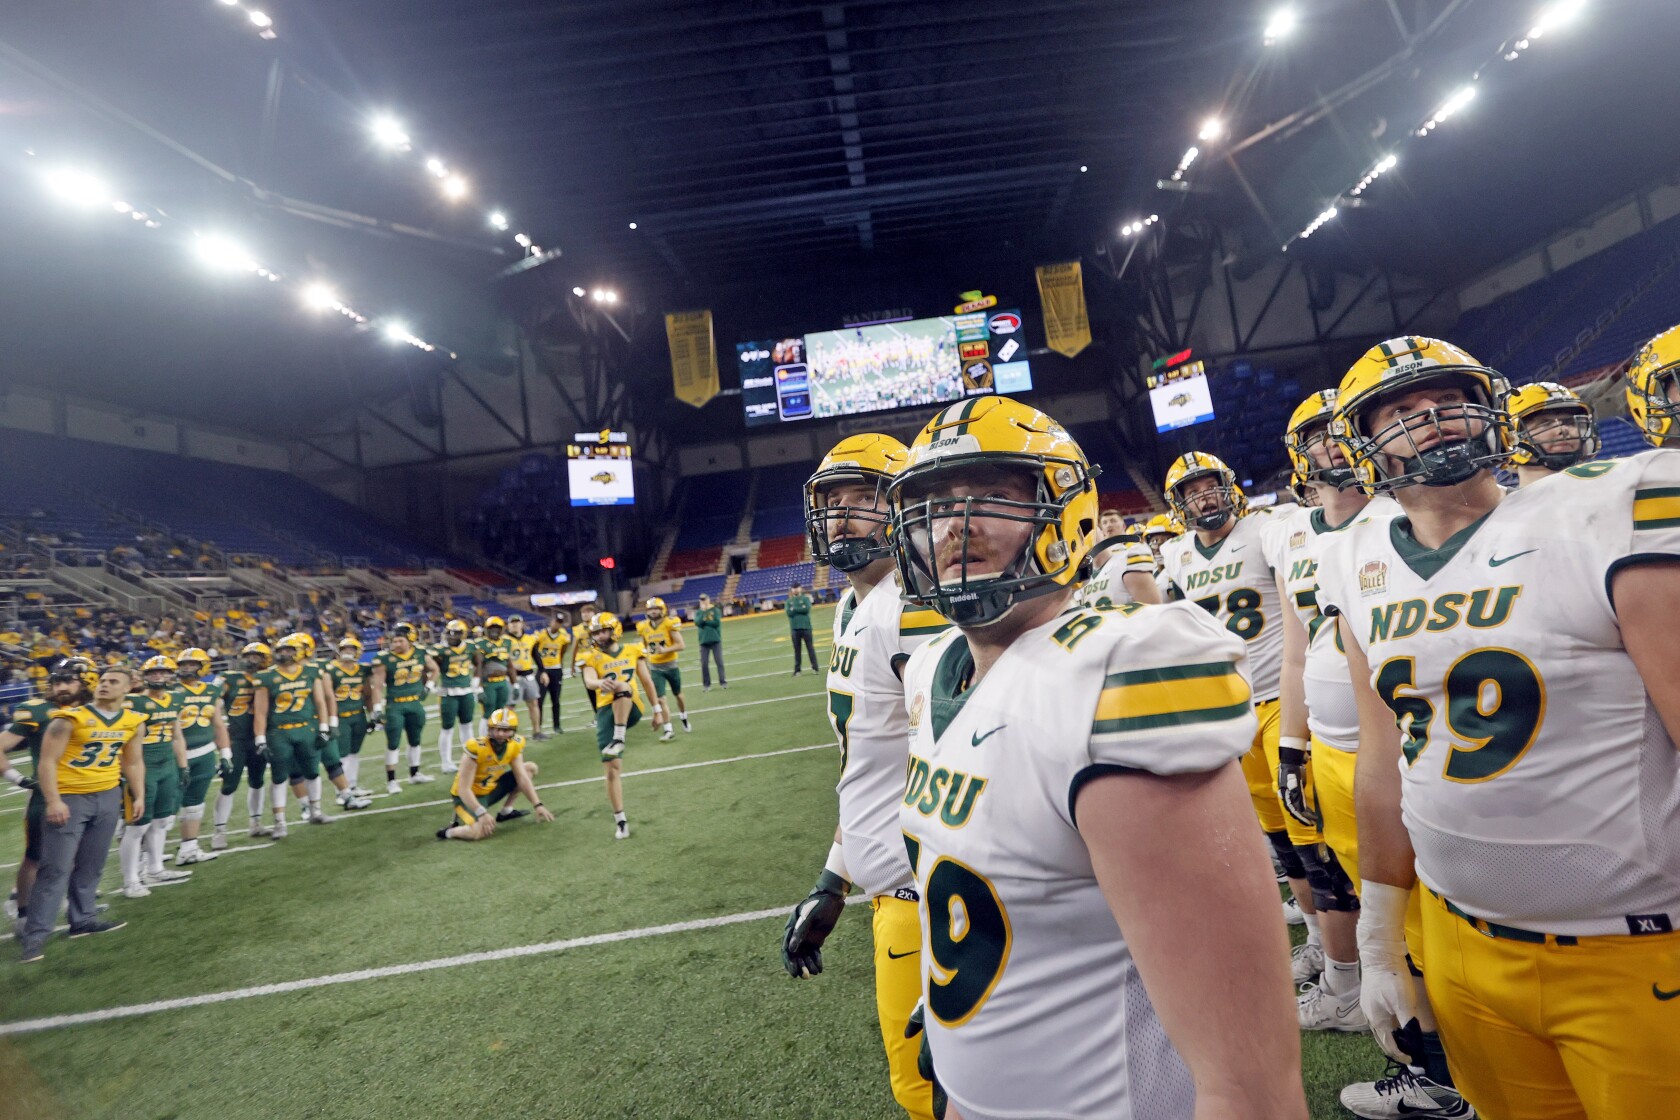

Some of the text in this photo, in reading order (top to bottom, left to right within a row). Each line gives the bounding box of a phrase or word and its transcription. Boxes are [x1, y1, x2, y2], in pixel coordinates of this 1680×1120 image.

[1394, 361, 1423, 375] BISON
[928, 437, 960, 451] BISON
[1186, 560, 1244, 592] NDSU
[1359, 571, 1387, 591] VALLEY
[1369, 584, 1525, 647] NDSU
[274, 687, 312, 714] 97
[1376, 646, 1548, 784] 69
[90, 730, 125, 739] BISON
[68, 741, 125, 768] 33
[897, 889, 917, 902] 2XL
[1636, 919, 1663, 932] XL
